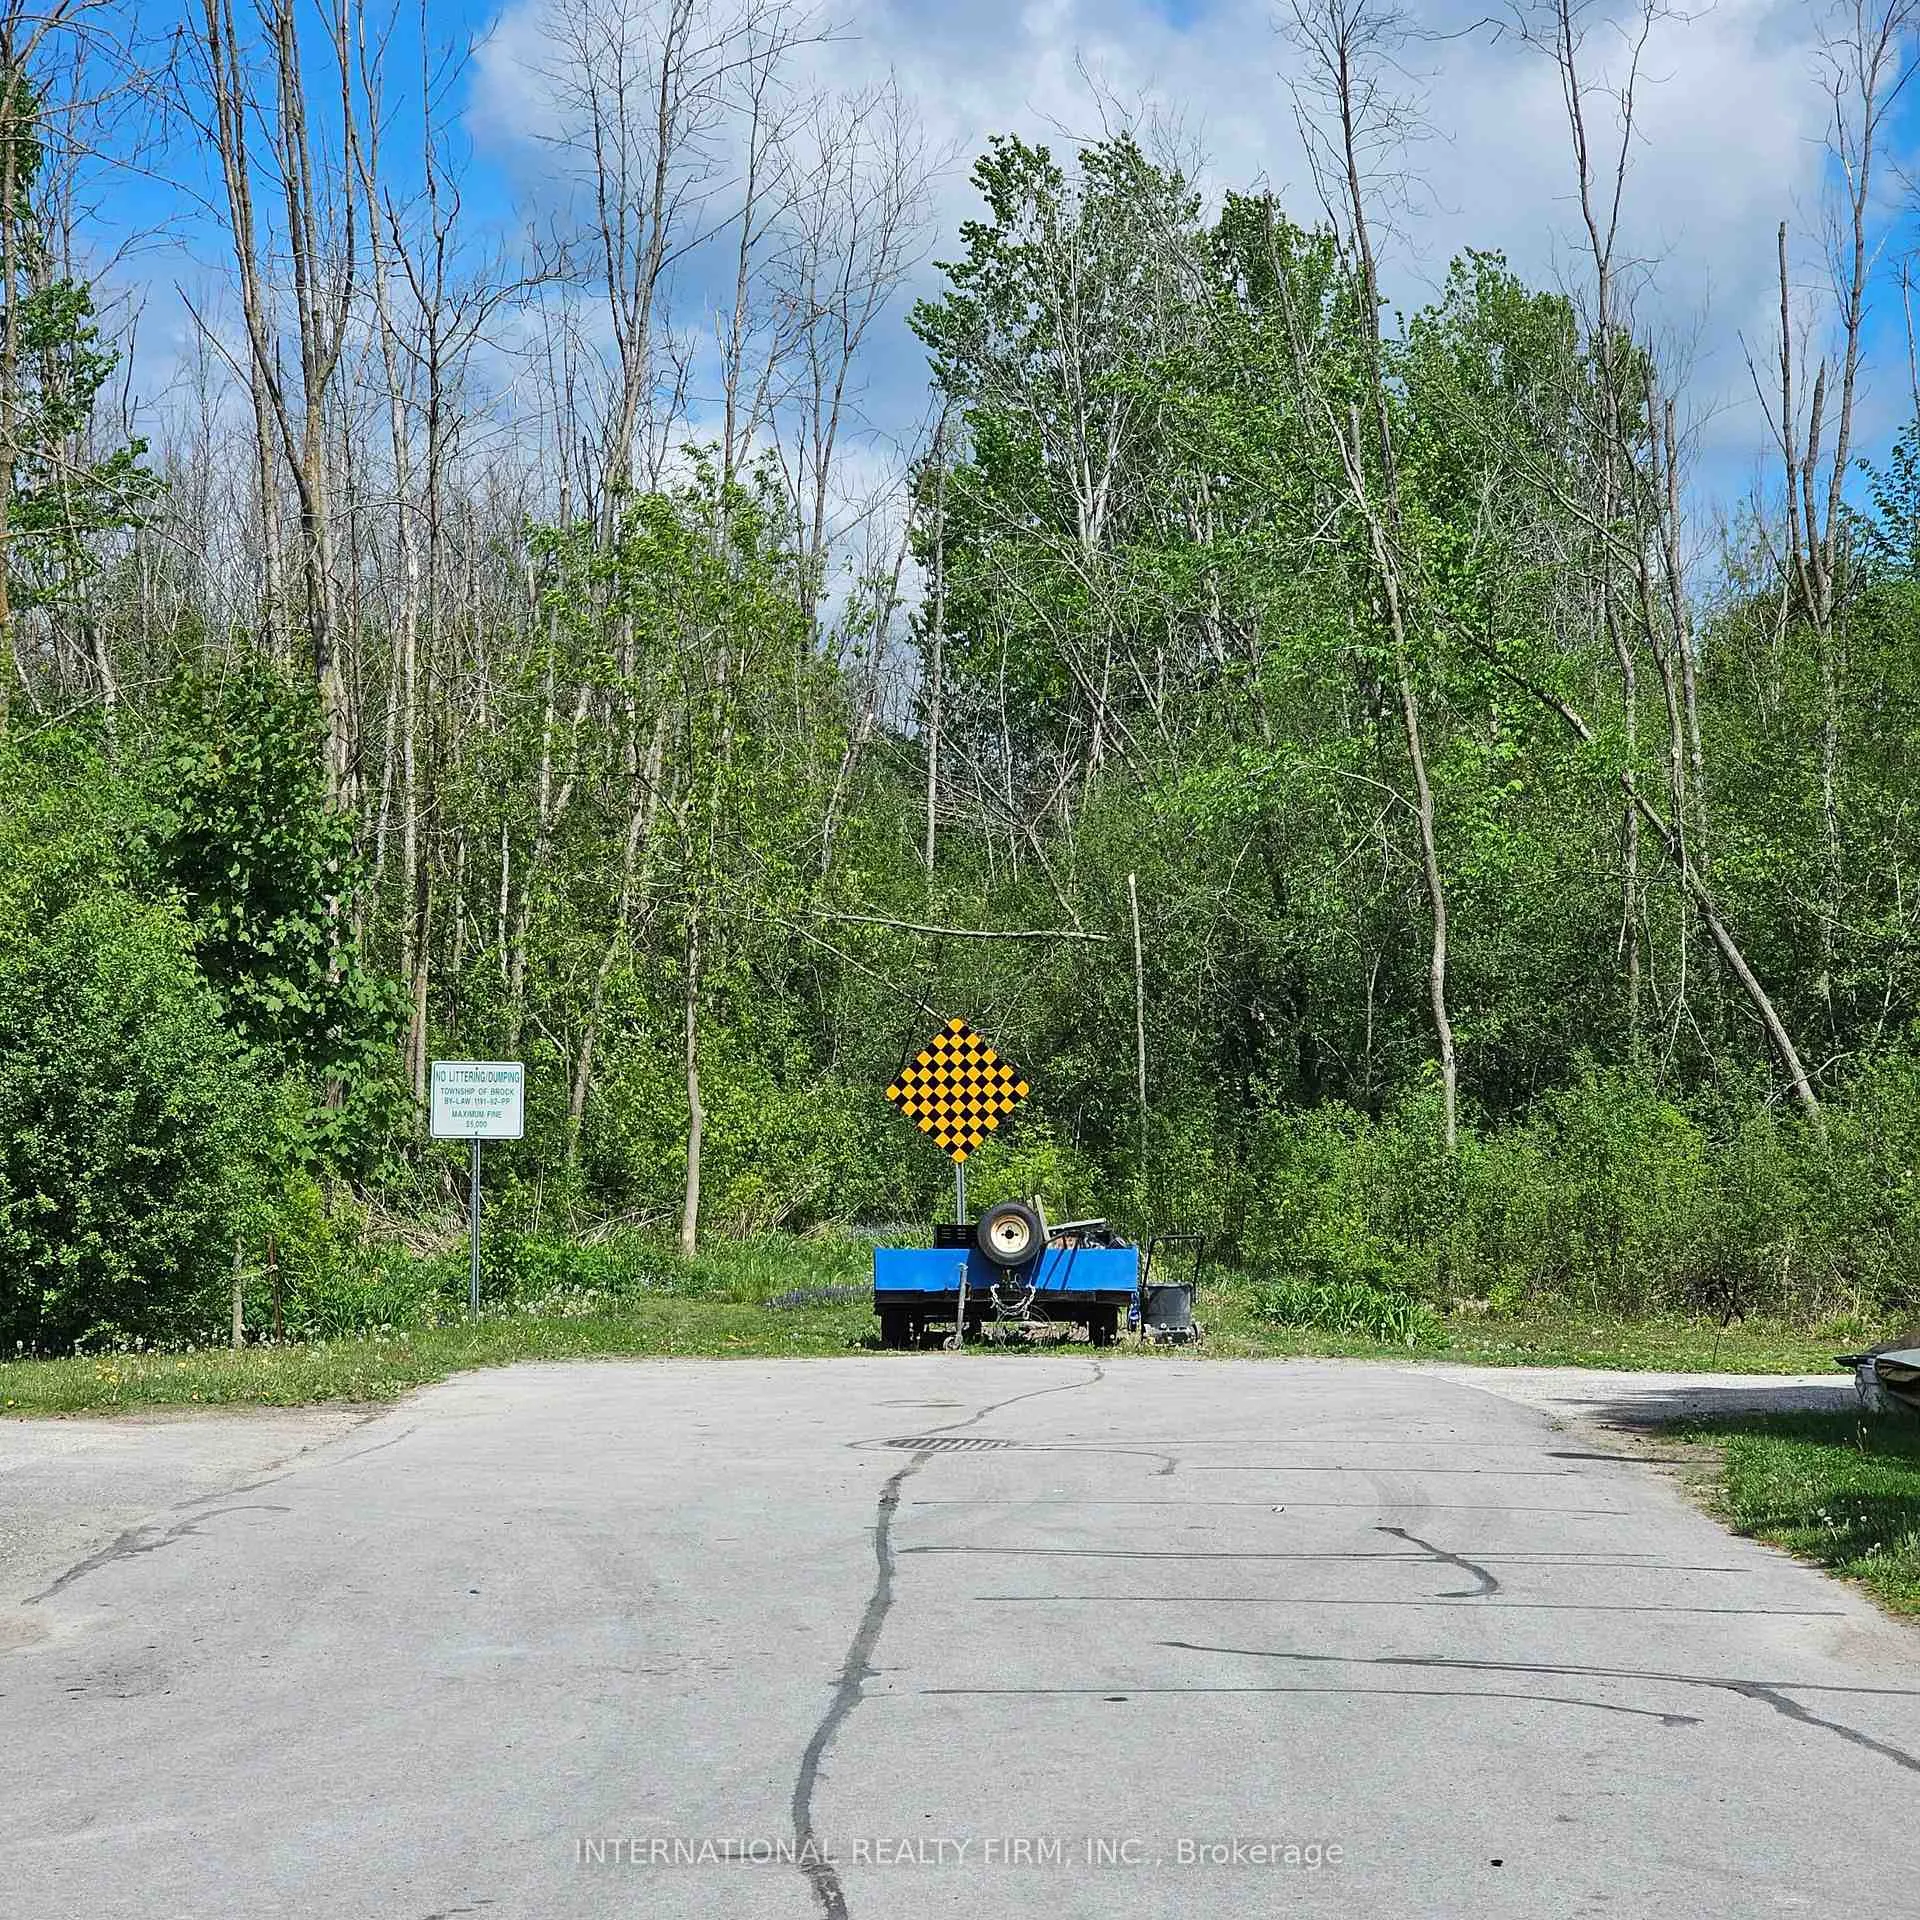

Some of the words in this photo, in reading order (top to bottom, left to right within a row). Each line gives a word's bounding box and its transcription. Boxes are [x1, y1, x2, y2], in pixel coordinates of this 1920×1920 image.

[436, 1070, 447, 1082] NO
[449, 1070, 520, 1083] LITTERING/DUMPING
[440, 1087, 475, 1096] TOWNSHIP
[478, 1087, 489, 1096] OF
[490, 1087, 515, 1096] BROCK
[444, 1097, 471, 1105] BY-LAW
[452, 1110, 485, 1119] MAXIMUM
[486, 1110, 503, 1119] FINE
